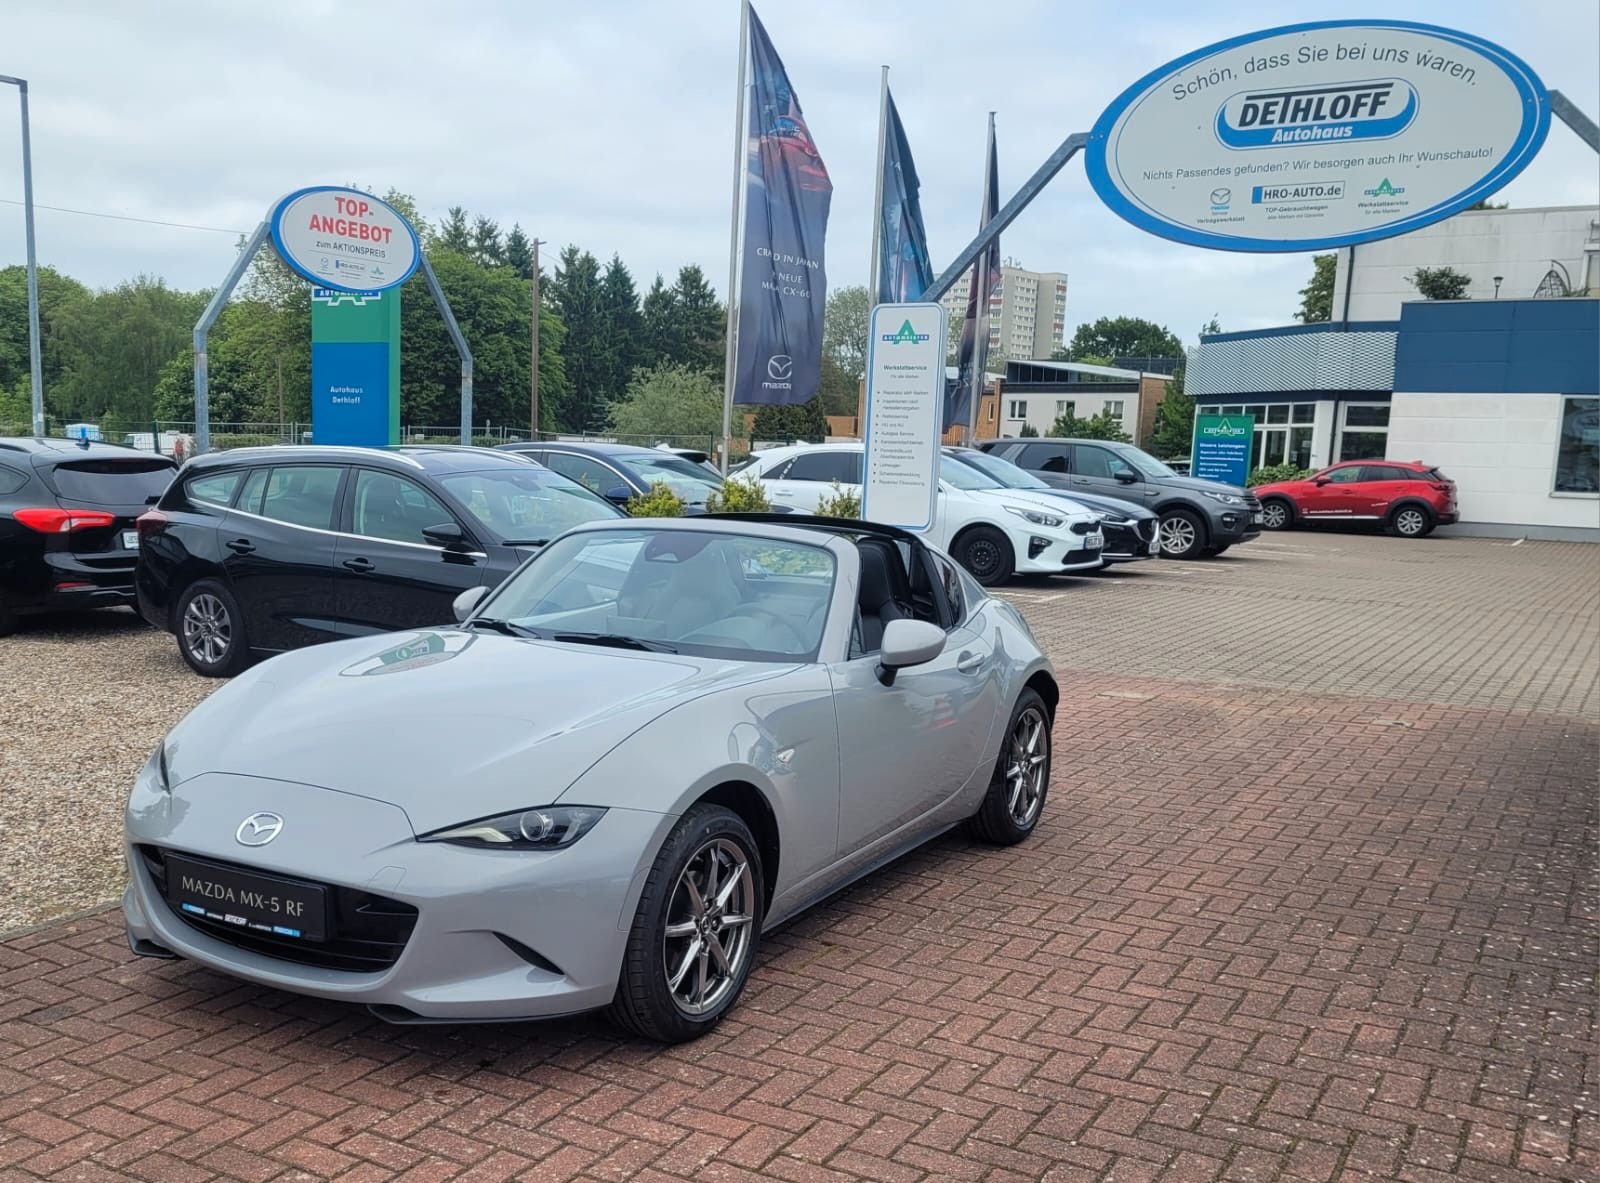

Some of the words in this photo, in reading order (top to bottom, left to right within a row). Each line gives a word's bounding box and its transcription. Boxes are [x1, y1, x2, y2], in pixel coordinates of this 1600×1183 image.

[1172, 67, 1238, 101] Schön,
[1244, 56, 1290, 74] dass
[1297, 45, 1329, 64] Sie
[1336, 43, 1367, 61] bei
[1372, 47, 1409, 63] uns
[1416, 51, 1476, 86] waren.
[1238, 83, 1394, 127] DETHLOFF
[1271, 126, 1353, 143] Autohaus
[1143, 170, 1173, 181] Nichts
[1175, 166, 1232, 179] Passendes
[1234, 161, 1290, 177] gefunden?
[1292, 160, 1311, 171] Wir
[1313, 158, 1365, 170] besorgen
[1367, 154, 1395, 166] auch
[1398, 153, 1414, 164] Ihr
[1417, 147, 1493, 162] Wunschauto!
[1263, 185, 1342, 200] HRO-AUTO.de
[334, 195, 374, 218] TOP-
[309, 214, 392, 244] ANGEBOT
[315, 241, 332, 249] zum
[333, 242, 386, 258] AKTIONSPREIS
[783, 254, 794, 264] IN
[778, 272, 804, 284] NEUE
[330, 386, 364, 394] Autohaus
[332, 396, 361, 404] Dethloff
[182, 875, 235, 903] MAZDA
[240, 890, 280, 913] MX-5
[286, 900, 305, 917] RF
